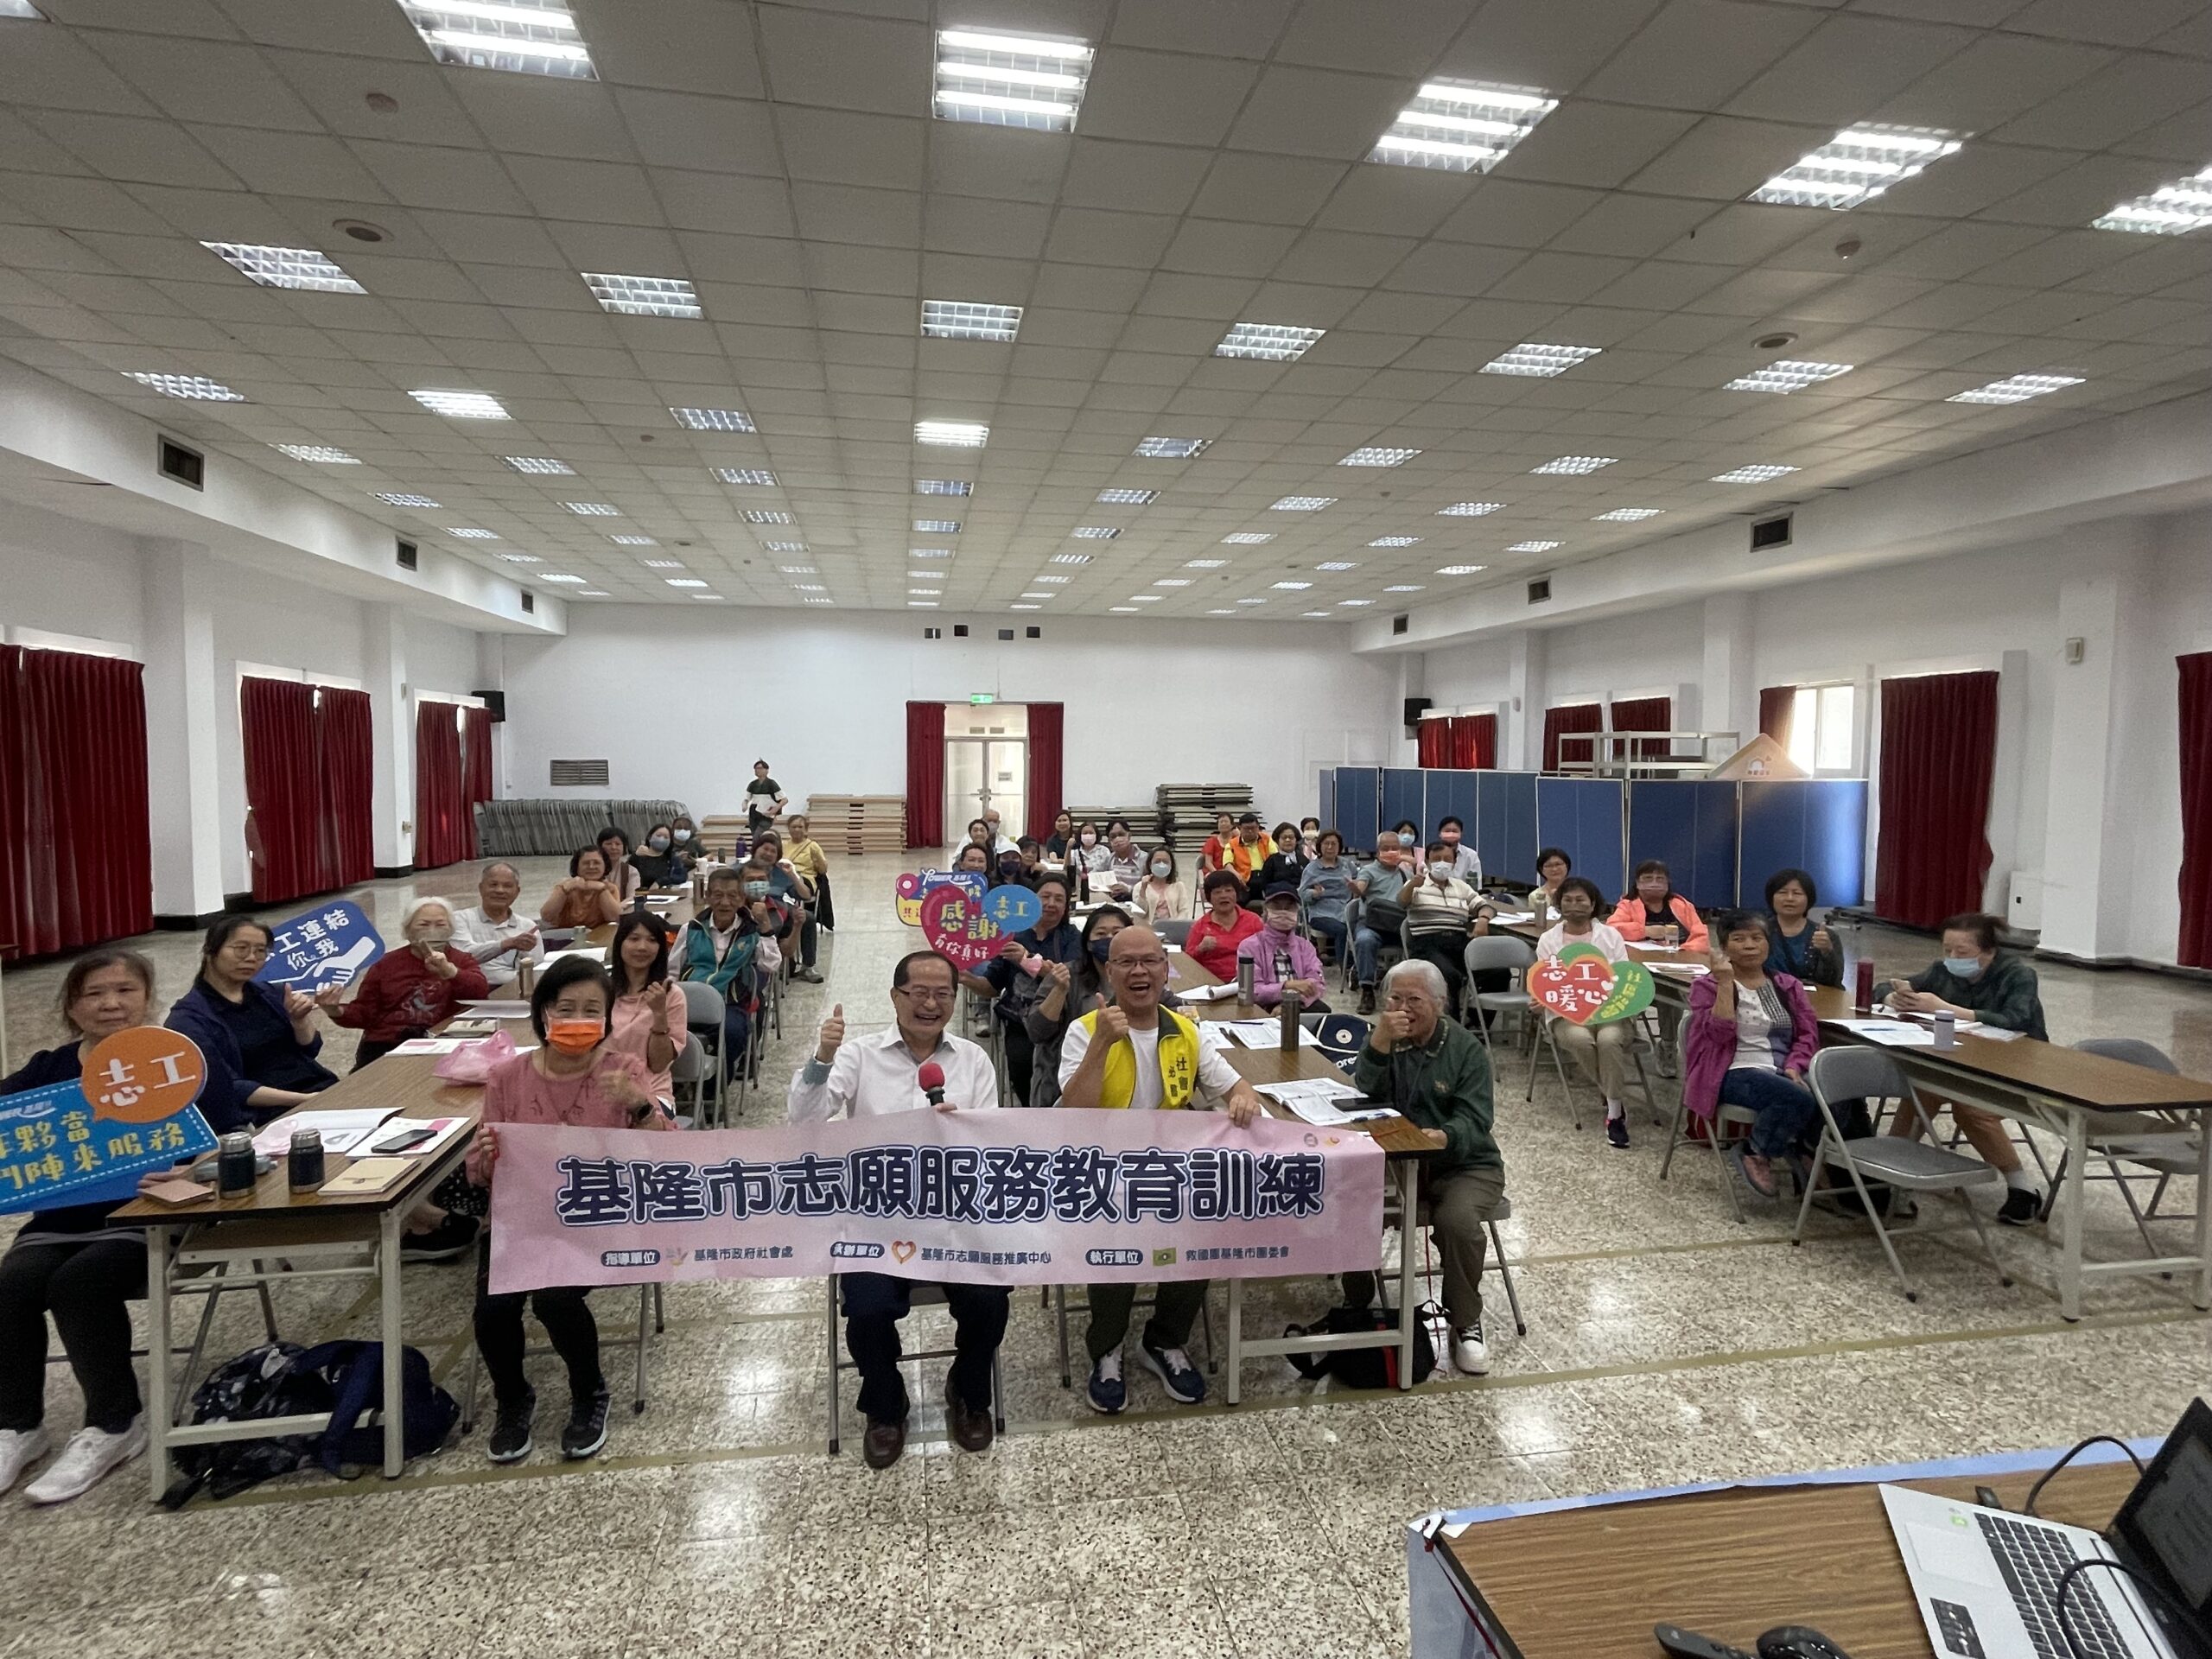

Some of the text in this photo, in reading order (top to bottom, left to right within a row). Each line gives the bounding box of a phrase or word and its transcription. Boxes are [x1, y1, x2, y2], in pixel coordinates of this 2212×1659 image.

[941, 899, 1000, 941] 感謝
[993, 895, 1029, 920] 志工
[265, 909, 350, 963] 工連結
[935, 933, 989, 962] 有你真好
[287, 938, 340, 971] 你我
[1541, 954, 1599, 982] 志工
[1545, 984, 1609, 1013] 暖心
[99, 1051, 197, 1108] 志工
[556, 1144, 1325, 1227] 基隆市志願服務教育訓練
[694, 1245, 794, 1262] 基隆市政府社會處
[921, 1247, 1052, 1265] 基隆市志願服務推廣中心
[1090, 1250, 1140, 1265] 執行單位
